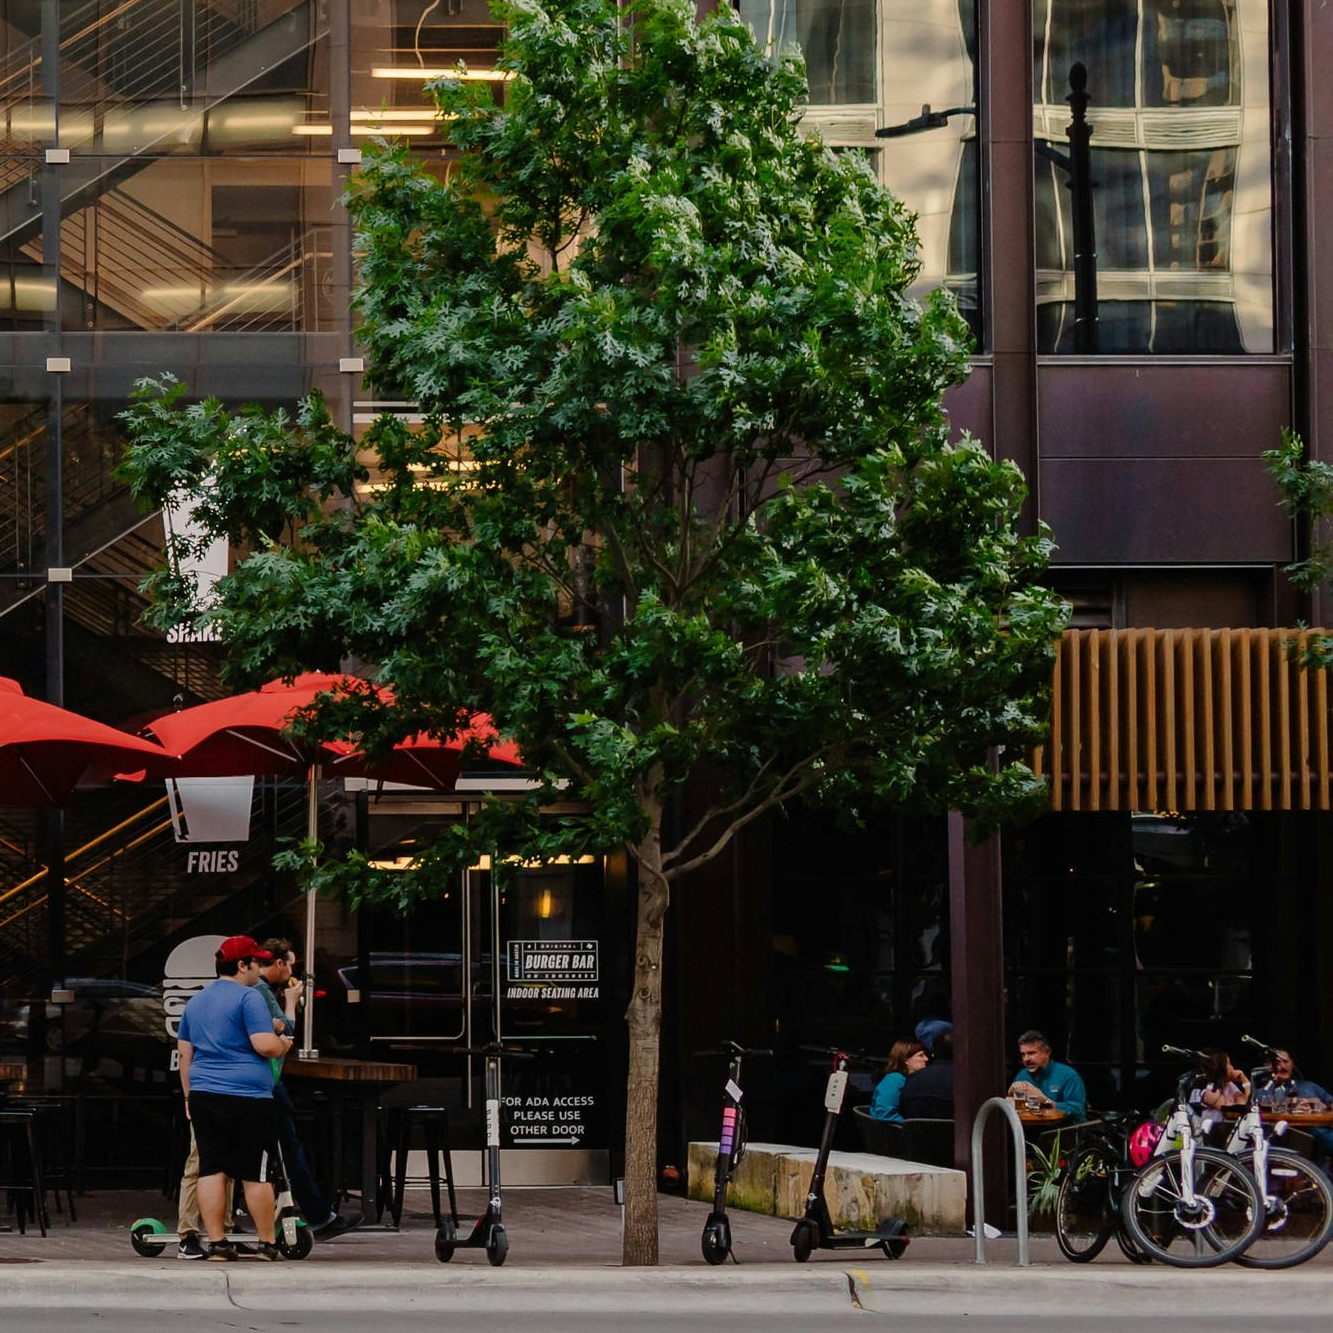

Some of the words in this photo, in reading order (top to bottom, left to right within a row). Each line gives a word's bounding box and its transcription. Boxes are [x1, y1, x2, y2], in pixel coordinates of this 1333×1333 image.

[187, 850, 239, 873] FRIES
[524, 954, 569, 969] BURGER
[571, 954, 595, 969] BAR
[507, 987, 540, 999] INDOOR
[541, 987, 577, 999] SEATING
[577, 987, 599, 999] AREA
[501, 1097, 522, 1106] FOR
[525, 1097, 550, 1106] ADA
[552, 1096, 595, 1106] ACCESS
[513, 1111, 555, 1120] PLEASE
[558, 1111, 581, 1120] USE
[510, 1125, 547, 1135] OTHER
[552, 1125, 585, 1135] DOOR
